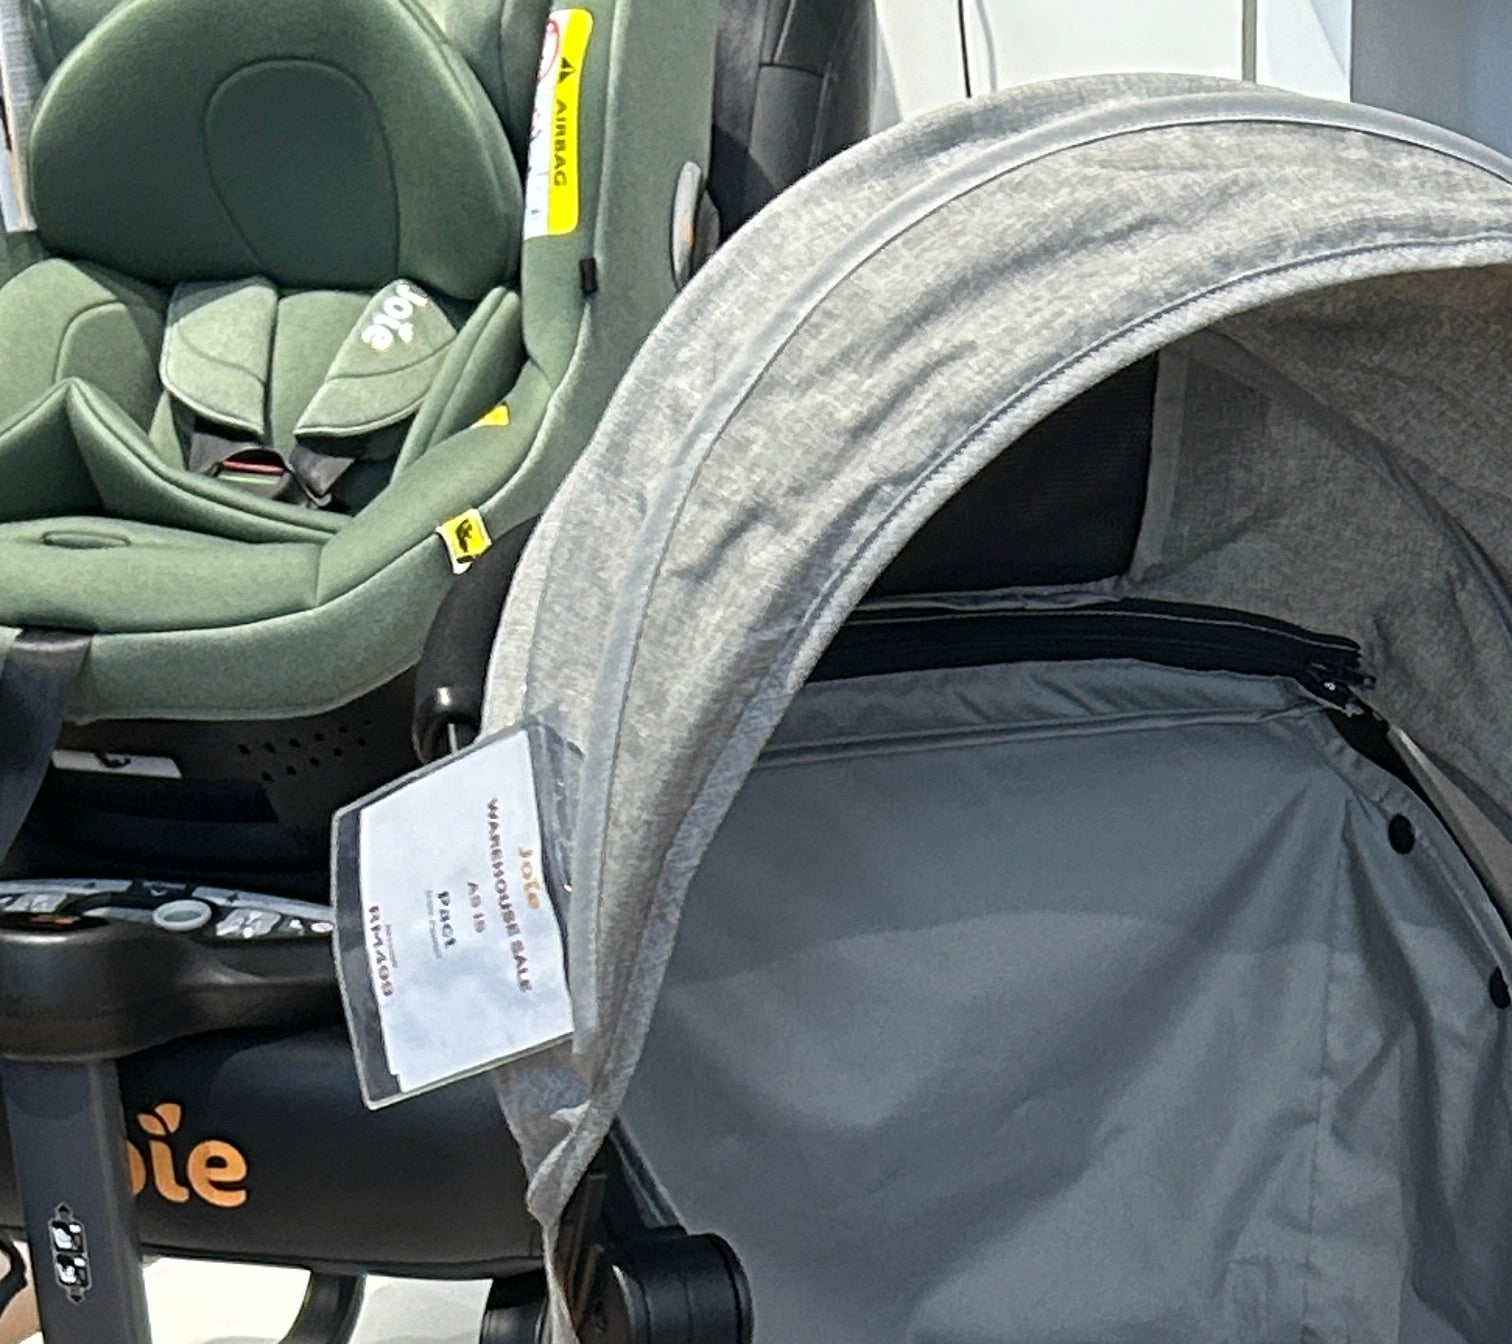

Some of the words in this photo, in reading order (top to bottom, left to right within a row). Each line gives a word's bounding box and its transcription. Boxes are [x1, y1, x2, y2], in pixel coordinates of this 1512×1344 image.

[553, 99, 568, 187] AIRBAG
[361, 284, 428, 351] Joie
[487, 797, 521, 937] WAREHOUSE
[510, 939, 533, 993] SALE
[518, 846, 540, 910] Joie
[436, 890, 456, 948] Pact
